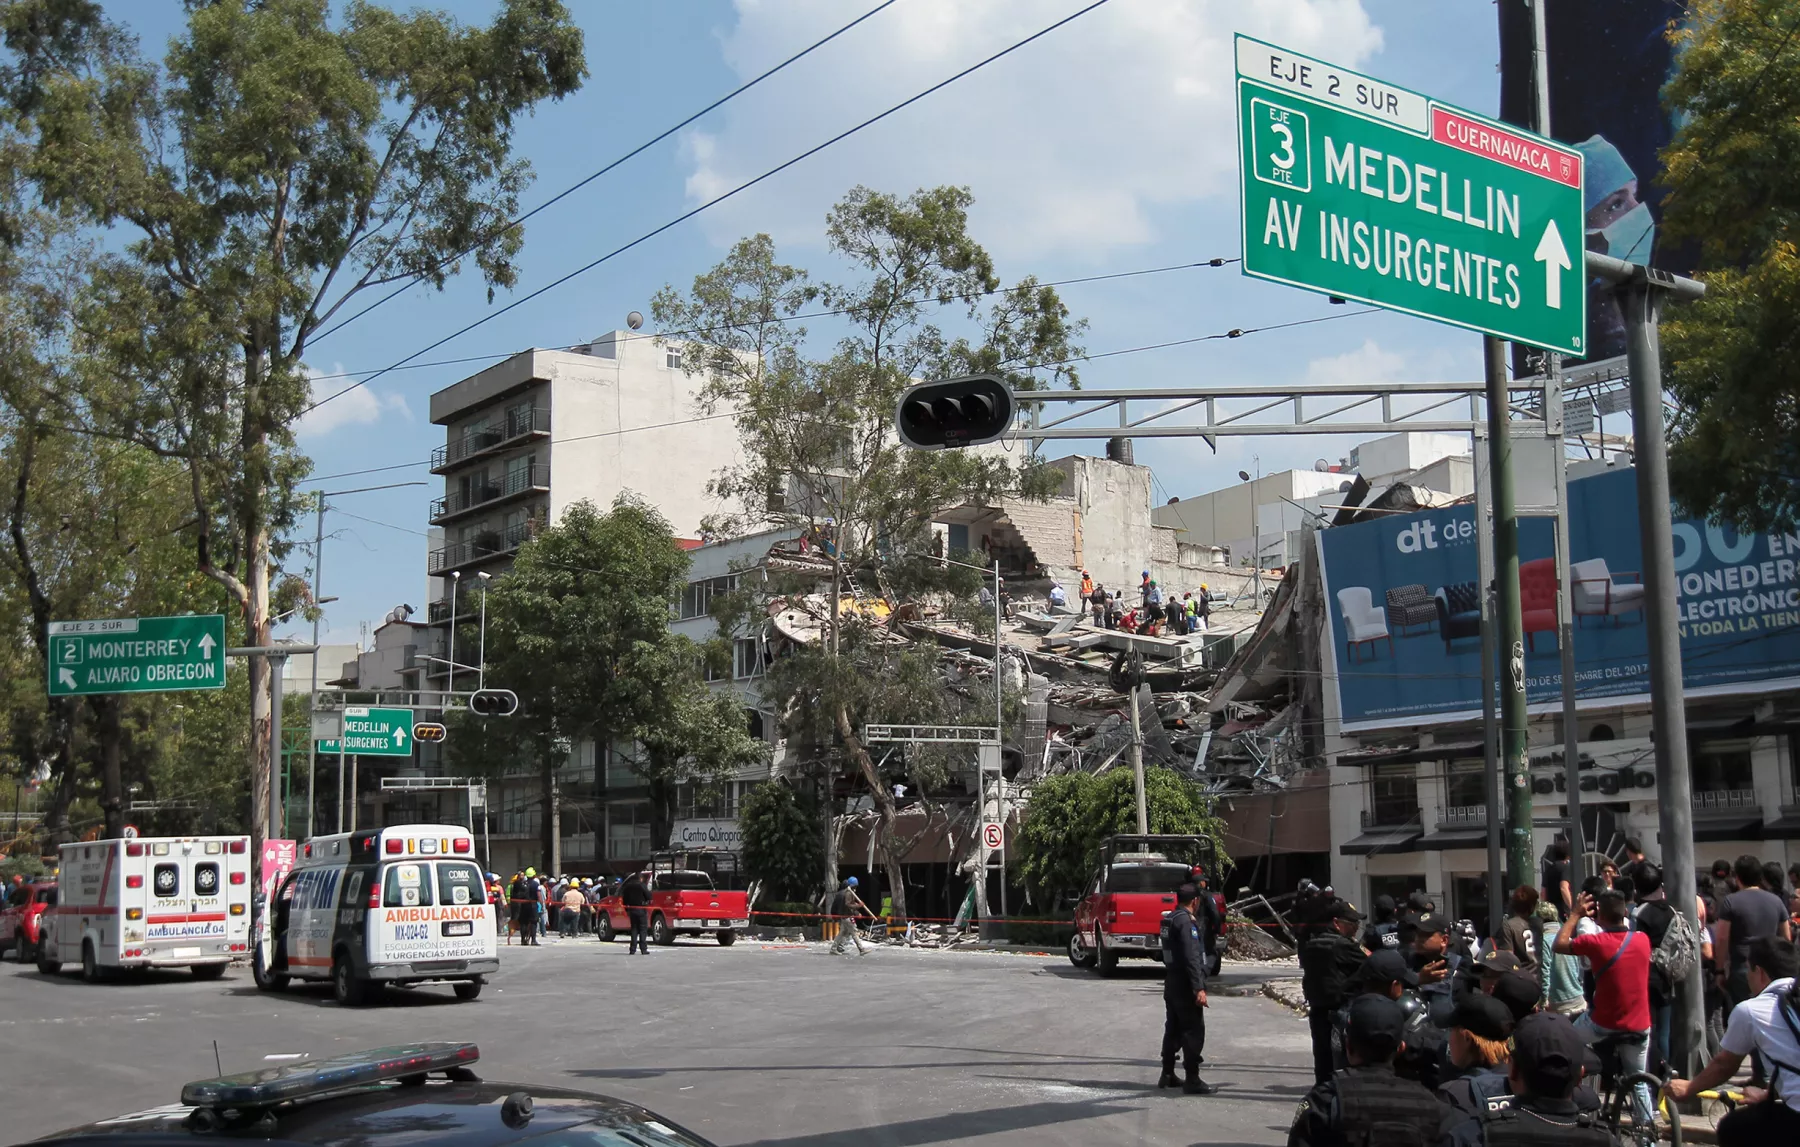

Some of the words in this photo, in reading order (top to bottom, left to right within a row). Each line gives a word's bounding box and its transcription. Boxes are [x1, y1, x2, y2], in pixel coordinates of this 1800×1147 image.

[1270, 55, 1312, 88] EJE
[1328, 75, 1340, 97] 2
[1356, 84, 1398, 116] SUR
[1269, 108, 1290, 124] EJE
[1269, 123, 1295, 169] 3
[1446, 120, 1550, 172] CUERNAVACA
[1272, 167, 1292, 183] PTE
[1324, 135, 1519, 238] MEDELLIN
[1263, 197, 1302, 251] AV
[1319, 210, 1520, 309] INSURGENTES
[1571, 336, 1581, 348] 10
[1396, 518, 1438, 554] dt
[1443, 518, 1477, 541] de
[1767, 530, 1800, 558] EN
[1674, 559, 1800, 597] ONEDER
[1677, 588, 1800, 622] LECTRÓNIC
[62, 622, 82, 632] EJE
[88, 622, 95, 631] 2
[102, 621, 123, 630] SUR
[1691, 620, 1734, 637] TODA
[1739, 617, 1759, 631] LA
[64, 643, 77, 659] 2
[89, 638, 191, 660] MONTERREY
[87, 665, 140, 684] ALVARO
[147, 662, 215, 682] OBREGON
[1526, 679, 1537, 688] 30
[1539, 676, 1550, 686] DE
[1605, 668, 1622, 679] DEL
[1625, 664, 1648, 676] 2017
[344, 721, 389, 733] MEDELLIN
[682, 827, 707, 842] Centro
[448, 870, 470, 879] CDMX
[385, 907, 485, 922] AMBULANCIA
[148, 925, 210, 937] AMBULANCIA
[212, 925, 224, 933] 04
[394, 924, 429, 941] MX-024-G2
[384, 941, 437, 951] ESCUADRÓN
[440, 941, 450, 949] DE
[452, 939, 485, 948] RESCATE
[385, 952, 391, 960] Y
[393, 950, 445, 960] URGENCIAS
[447, 947, 485, 957] MÉDICAS
